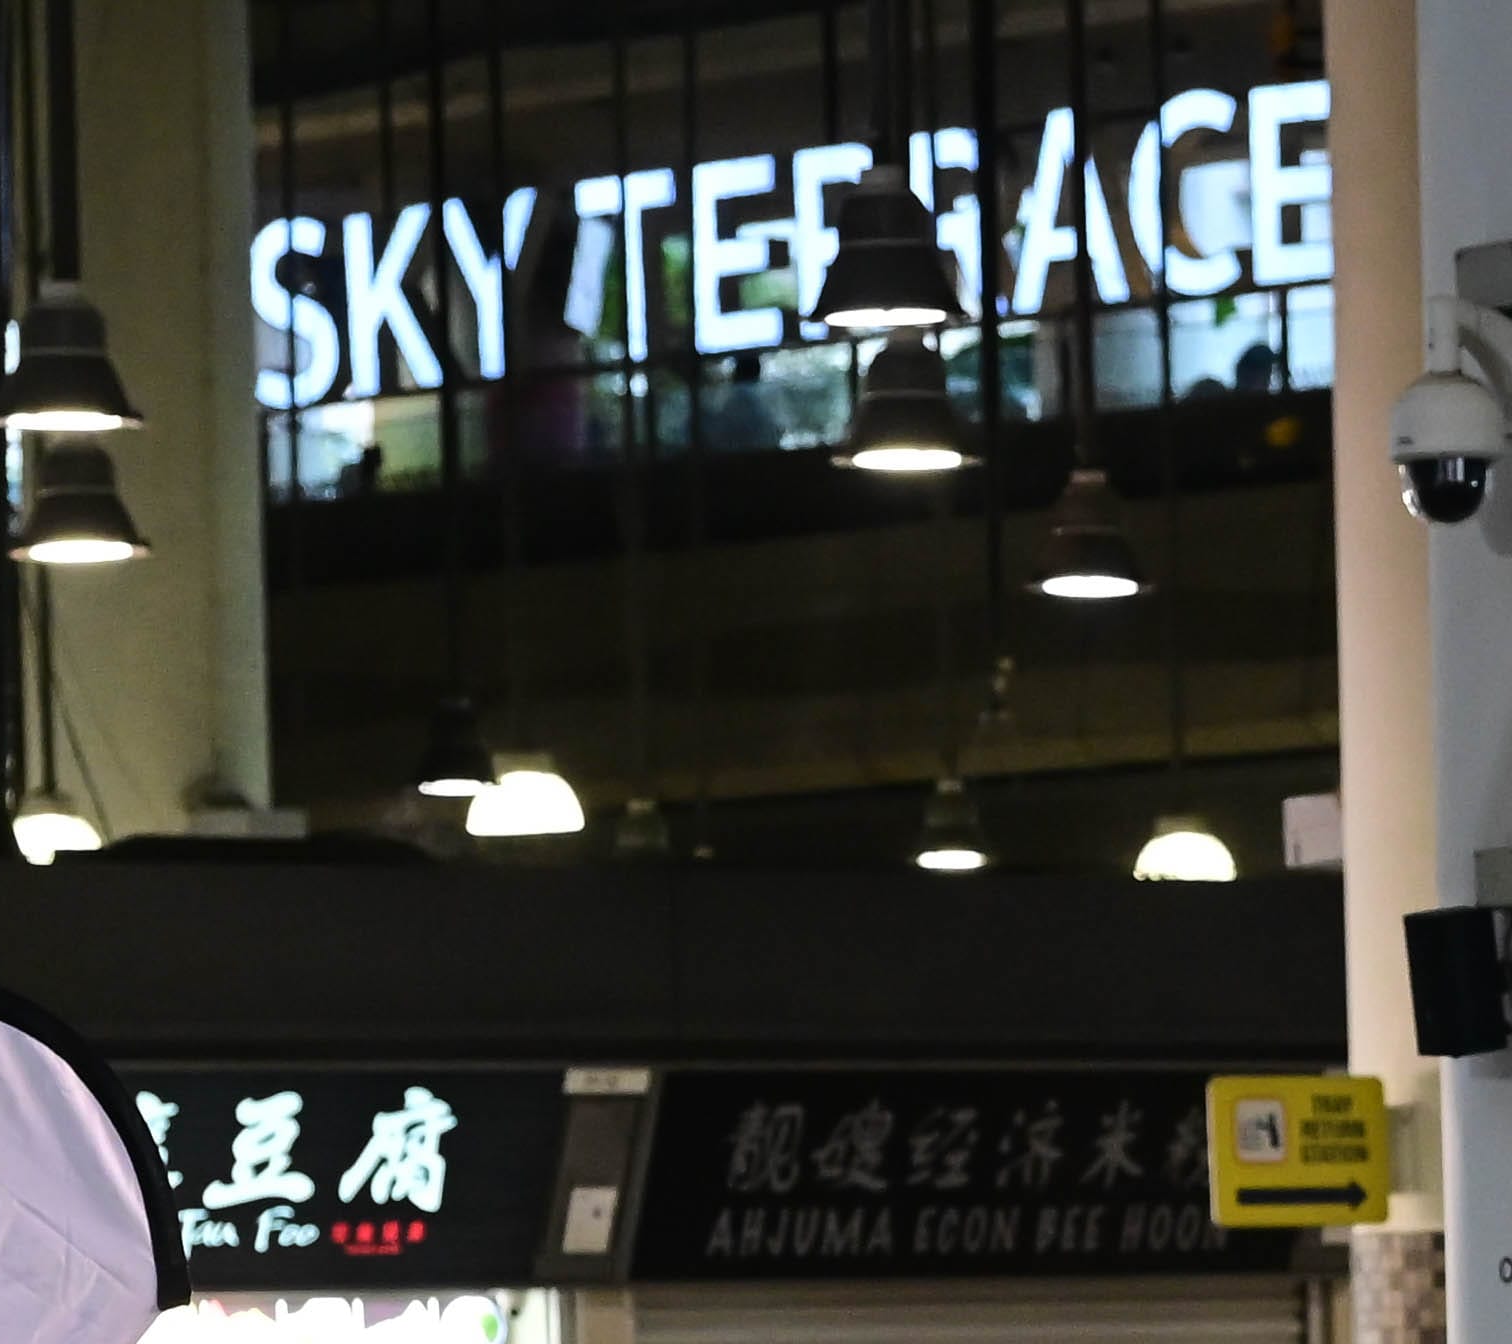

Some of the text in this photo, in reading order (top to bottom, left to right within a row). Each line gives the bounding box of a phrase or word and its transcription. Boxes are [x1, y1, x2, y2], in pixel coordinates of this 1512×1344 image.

[250, 186, 538, 411] SKY
[254, 1205, 320, 1253] Foo
[706, 1208, 891, 1258] AHJUMA
[913, 1206, 1017, 1256] ECON
[1034, 1206, 1104, 1254] BEE
